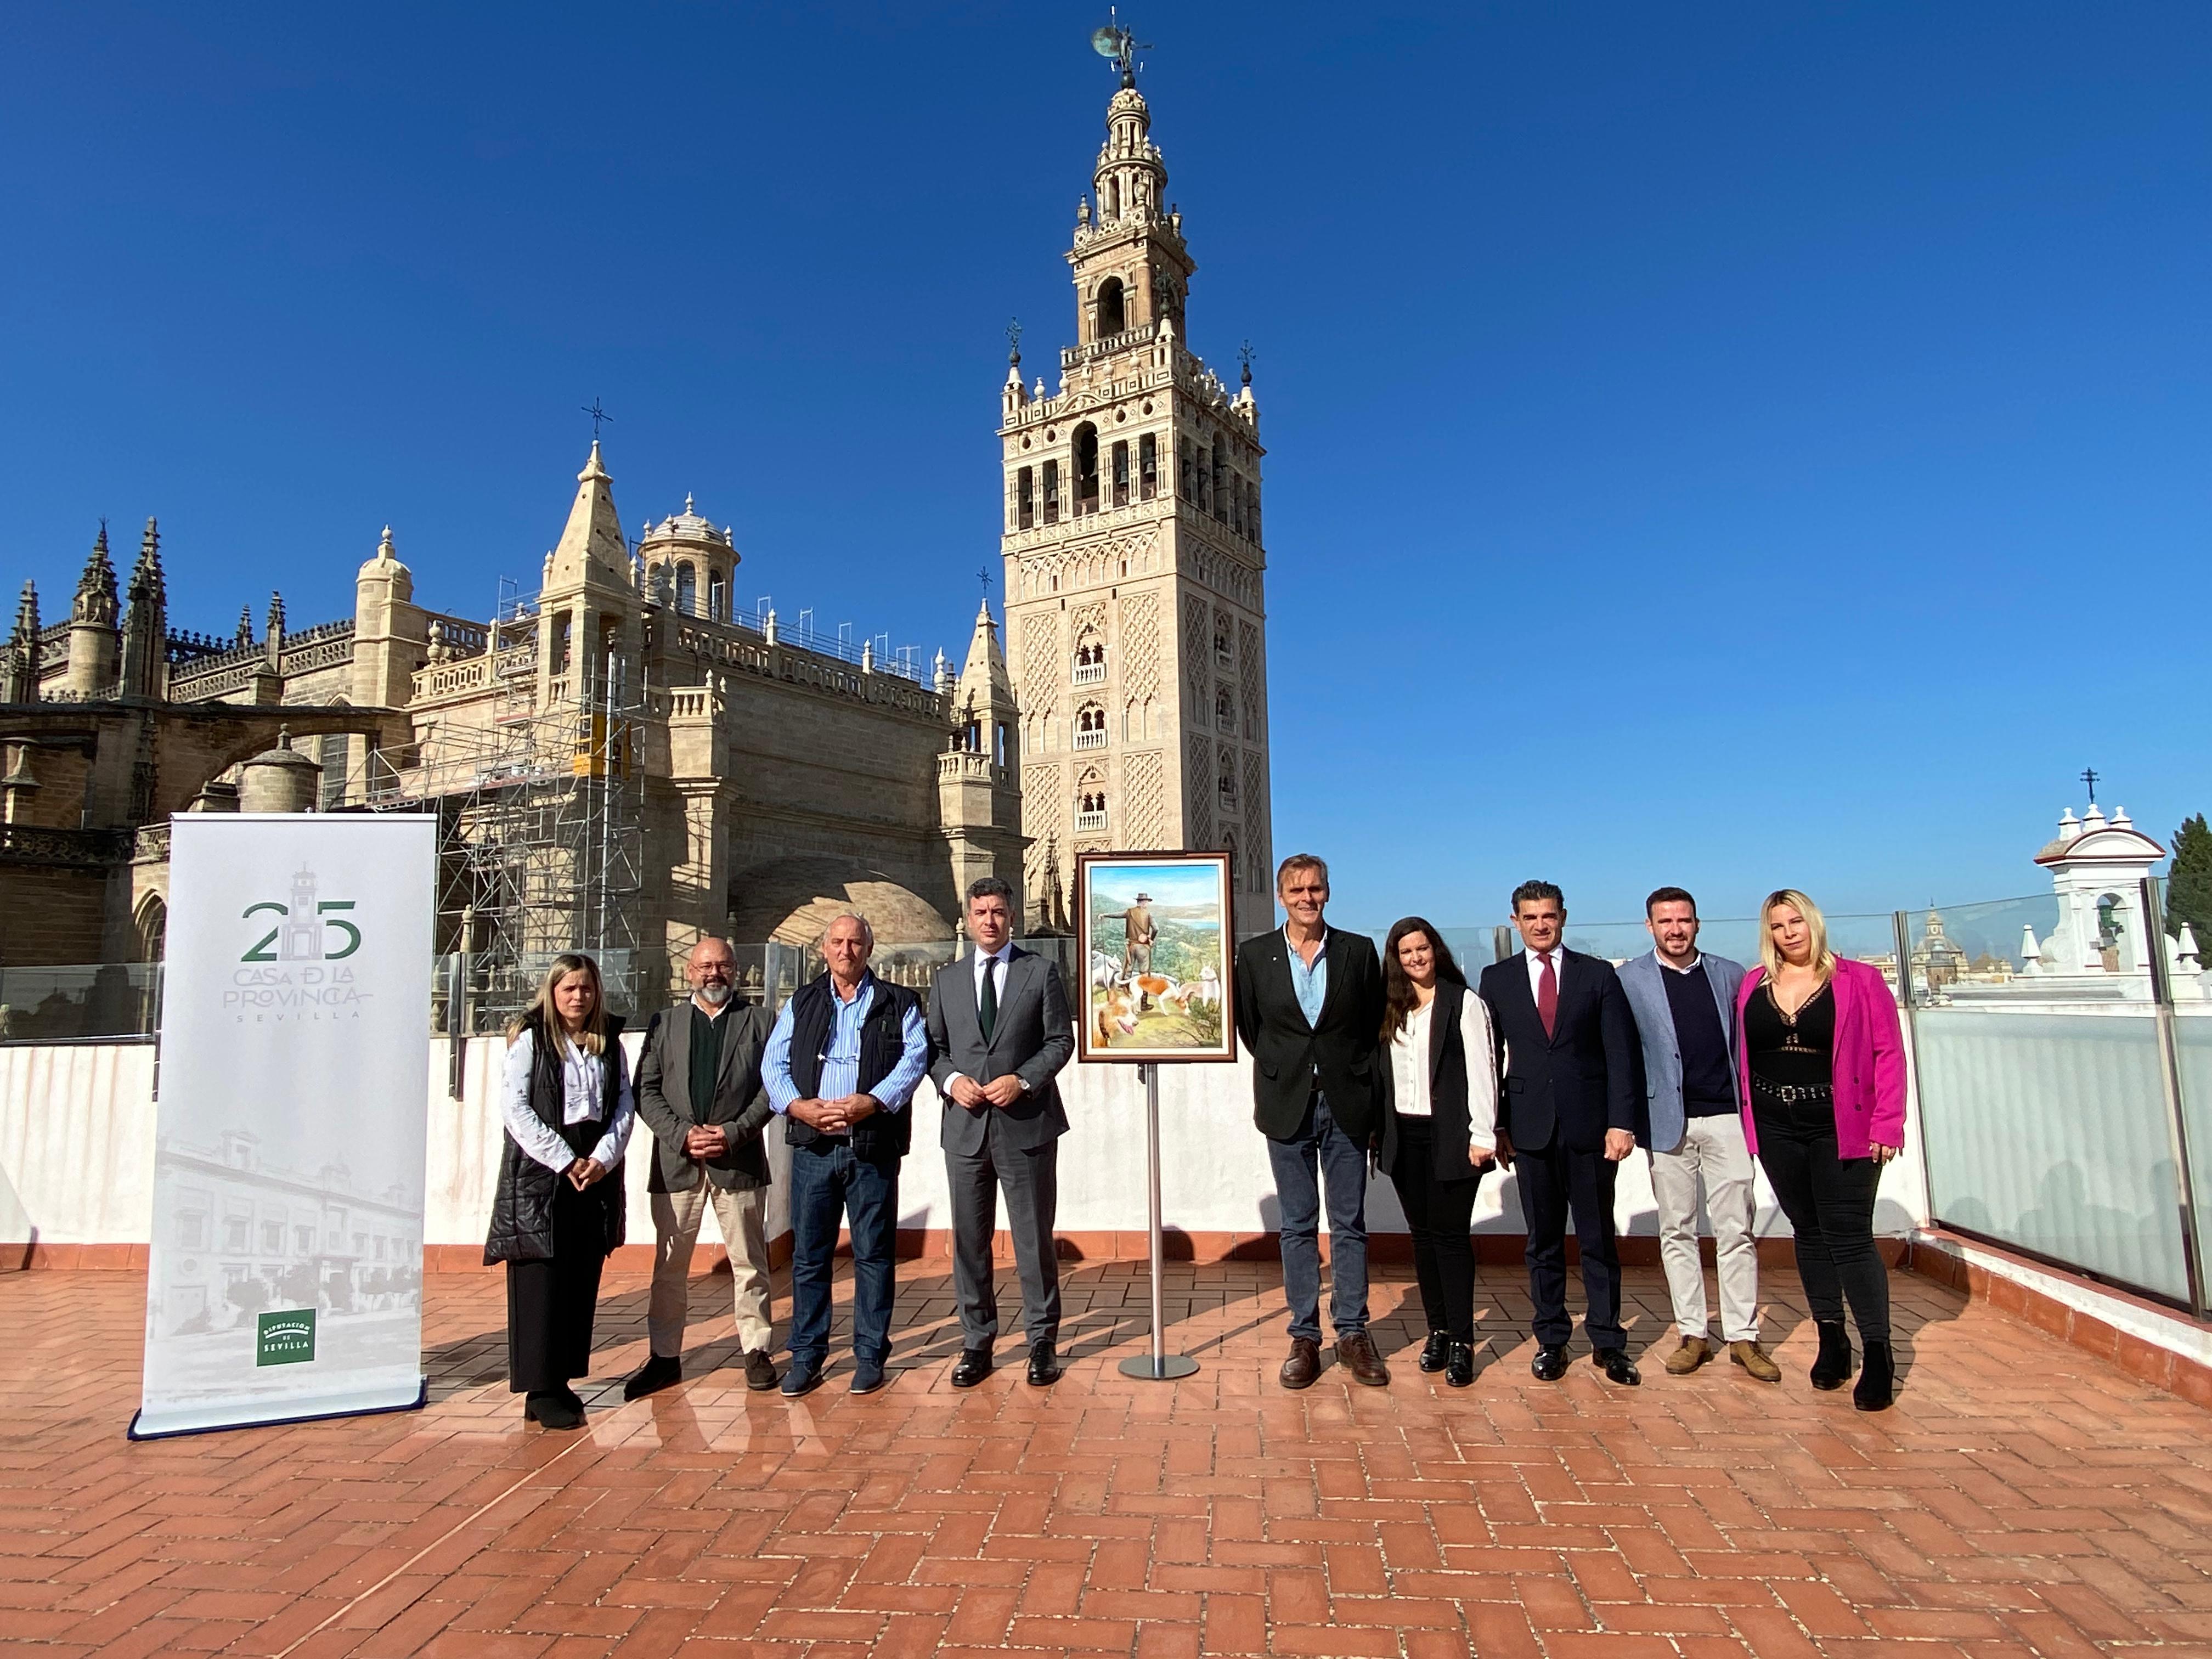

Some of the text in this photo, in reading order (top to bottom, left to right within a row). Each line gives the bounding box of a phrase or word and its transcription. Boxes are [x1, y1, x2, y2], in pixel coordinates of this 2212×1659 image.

[241, 901, 361, 962] 25
[233, 967, 292, 986] CASA
[332, 966, 354, 983] LA
[236, 1011, 359, 1023] SEVILLA
[264, 1341, 308, 1352] SEVILLA
